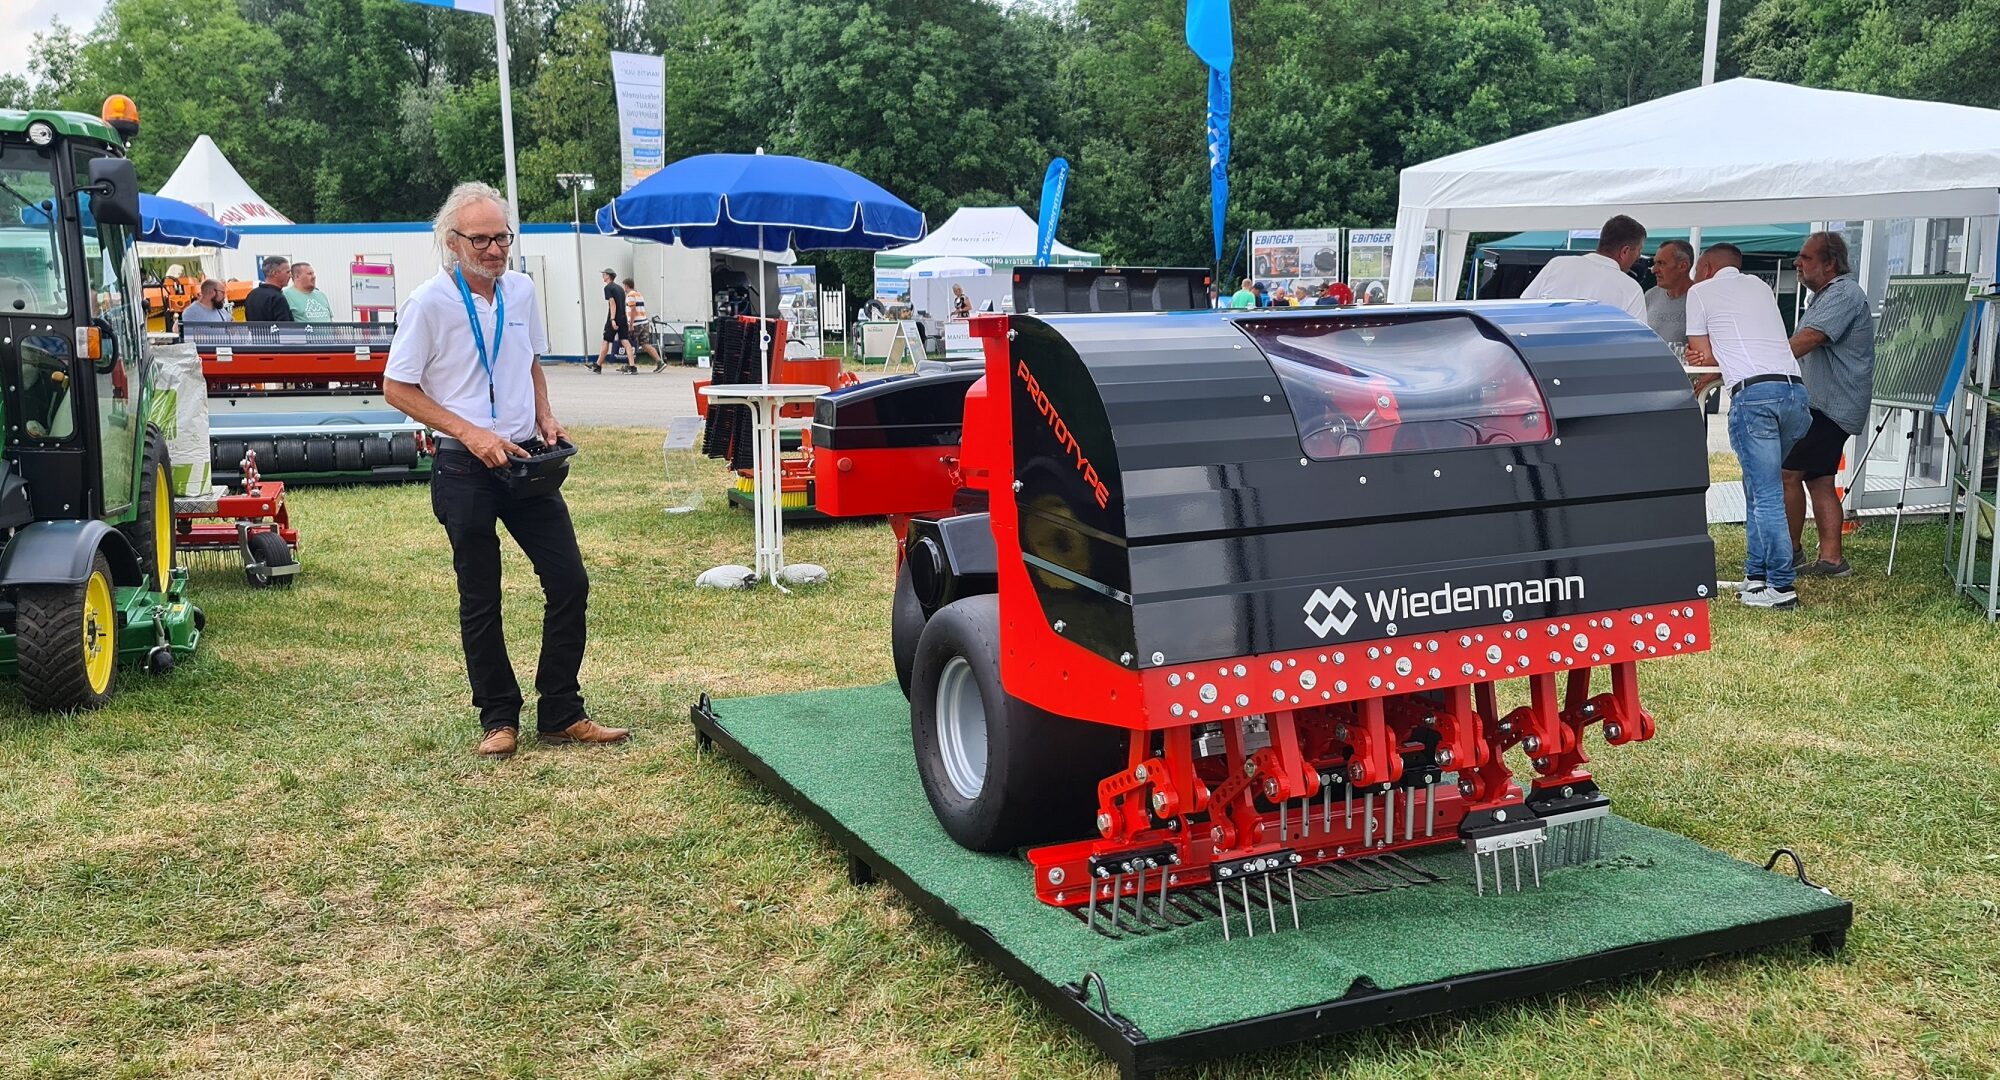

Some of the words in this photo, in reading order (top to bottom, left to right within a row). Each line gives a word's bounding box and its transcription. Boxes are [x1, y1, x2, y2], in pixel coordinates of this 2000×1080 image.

[1004, 257, 1034, 265] SYSTEMS
[1017, 359, 1110, 510] PROTOTYPE
[1364, 575, 1585, 623] Wiedenmann
